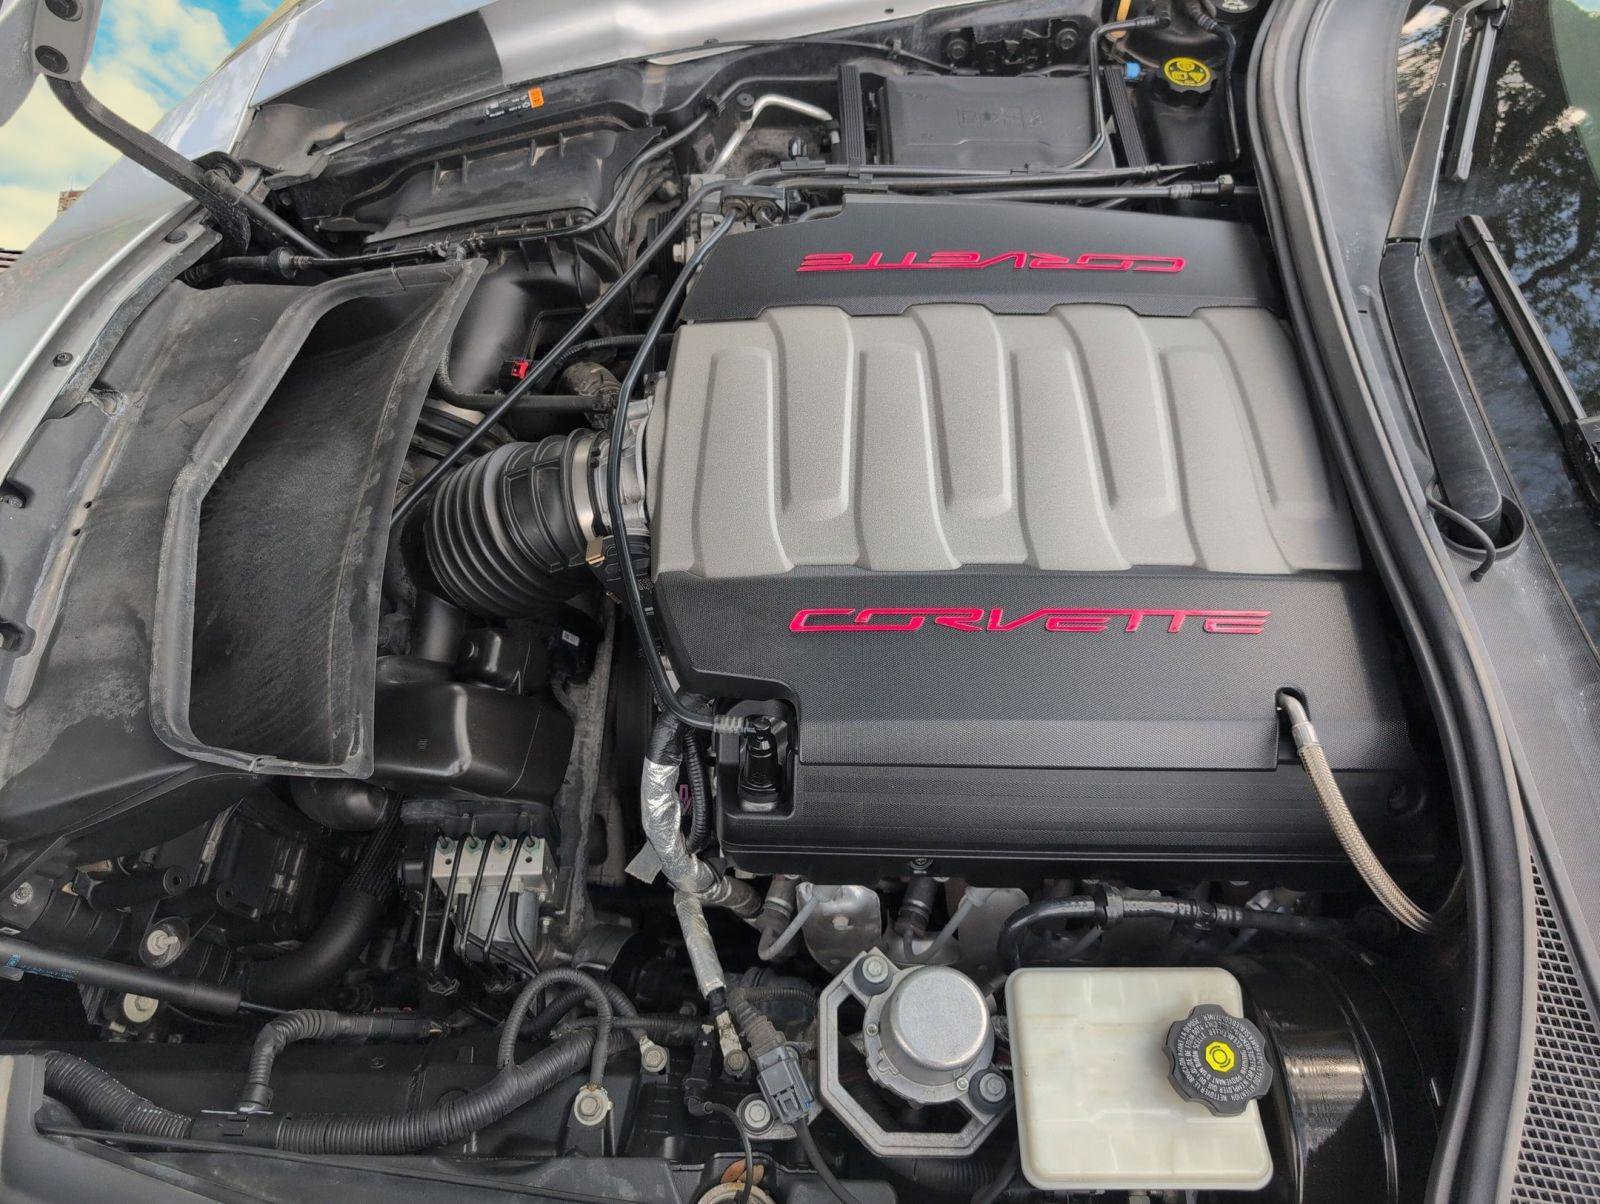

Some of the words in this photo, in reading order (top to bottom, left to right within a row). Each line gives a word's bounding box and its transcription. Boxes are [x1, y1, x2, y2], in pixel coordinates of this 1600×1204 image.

[797, 250, 1188, 273] CORVETTE
[788, 607, 1271, 634] CORVETTE
[1192, 1081, 1201, 1090] LE
[1212, 1074, 1241, 1085] PROVENANT
[1200, 1087, 1227, 1101] NETTOYER
[1207, 1082, 1217, 1092] QUE
[1231, 1084, 1255, 1101] ATTENTION
